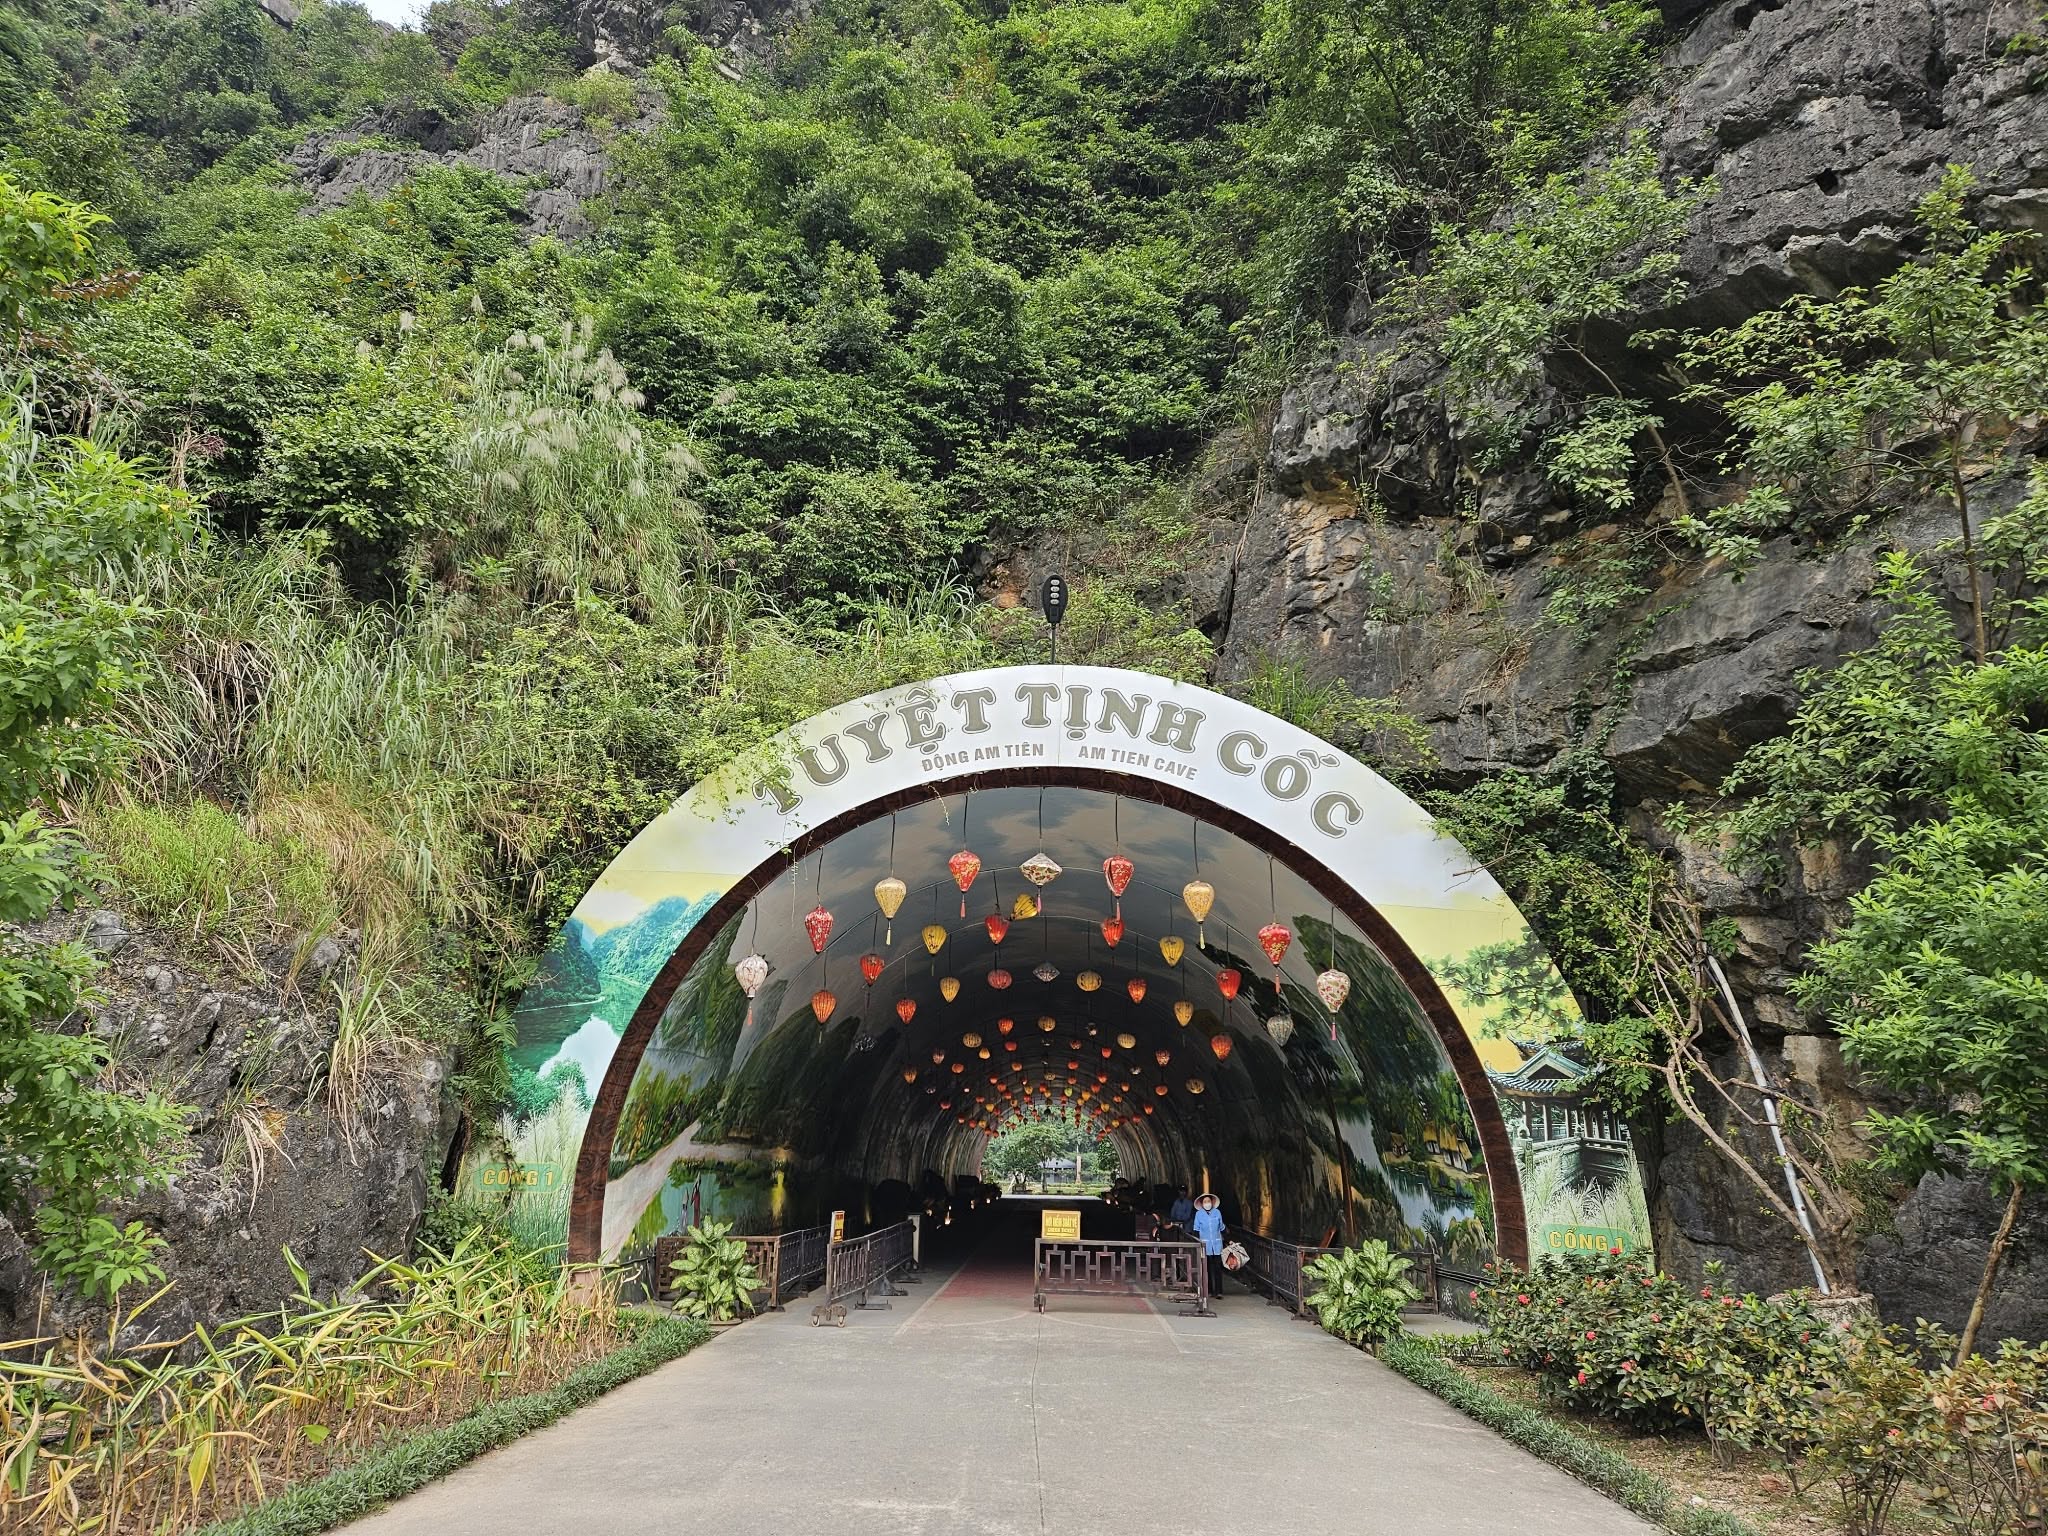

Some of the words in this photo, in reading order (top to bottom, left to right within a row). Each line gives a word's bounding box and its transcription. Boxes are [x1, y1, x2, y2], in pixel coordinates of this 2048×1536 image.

[752, 687, 996, 815] TUYỆT
[1015, 683, 1206, 753] TỊNH
[1217, 730, 1364, 838] CỐC
[921, 750, 969, 771] ĐỘNG
[974, 746, 1000, 760] AM
[1004, 741, 1044, 757] TIÊN
[1078, 745, 1106, 760] AM
[1111, 749, 1150, 767] TIEN
[1154, 757, 1198, 780] CAVE
[545, 1170, 553, 1186] 1
